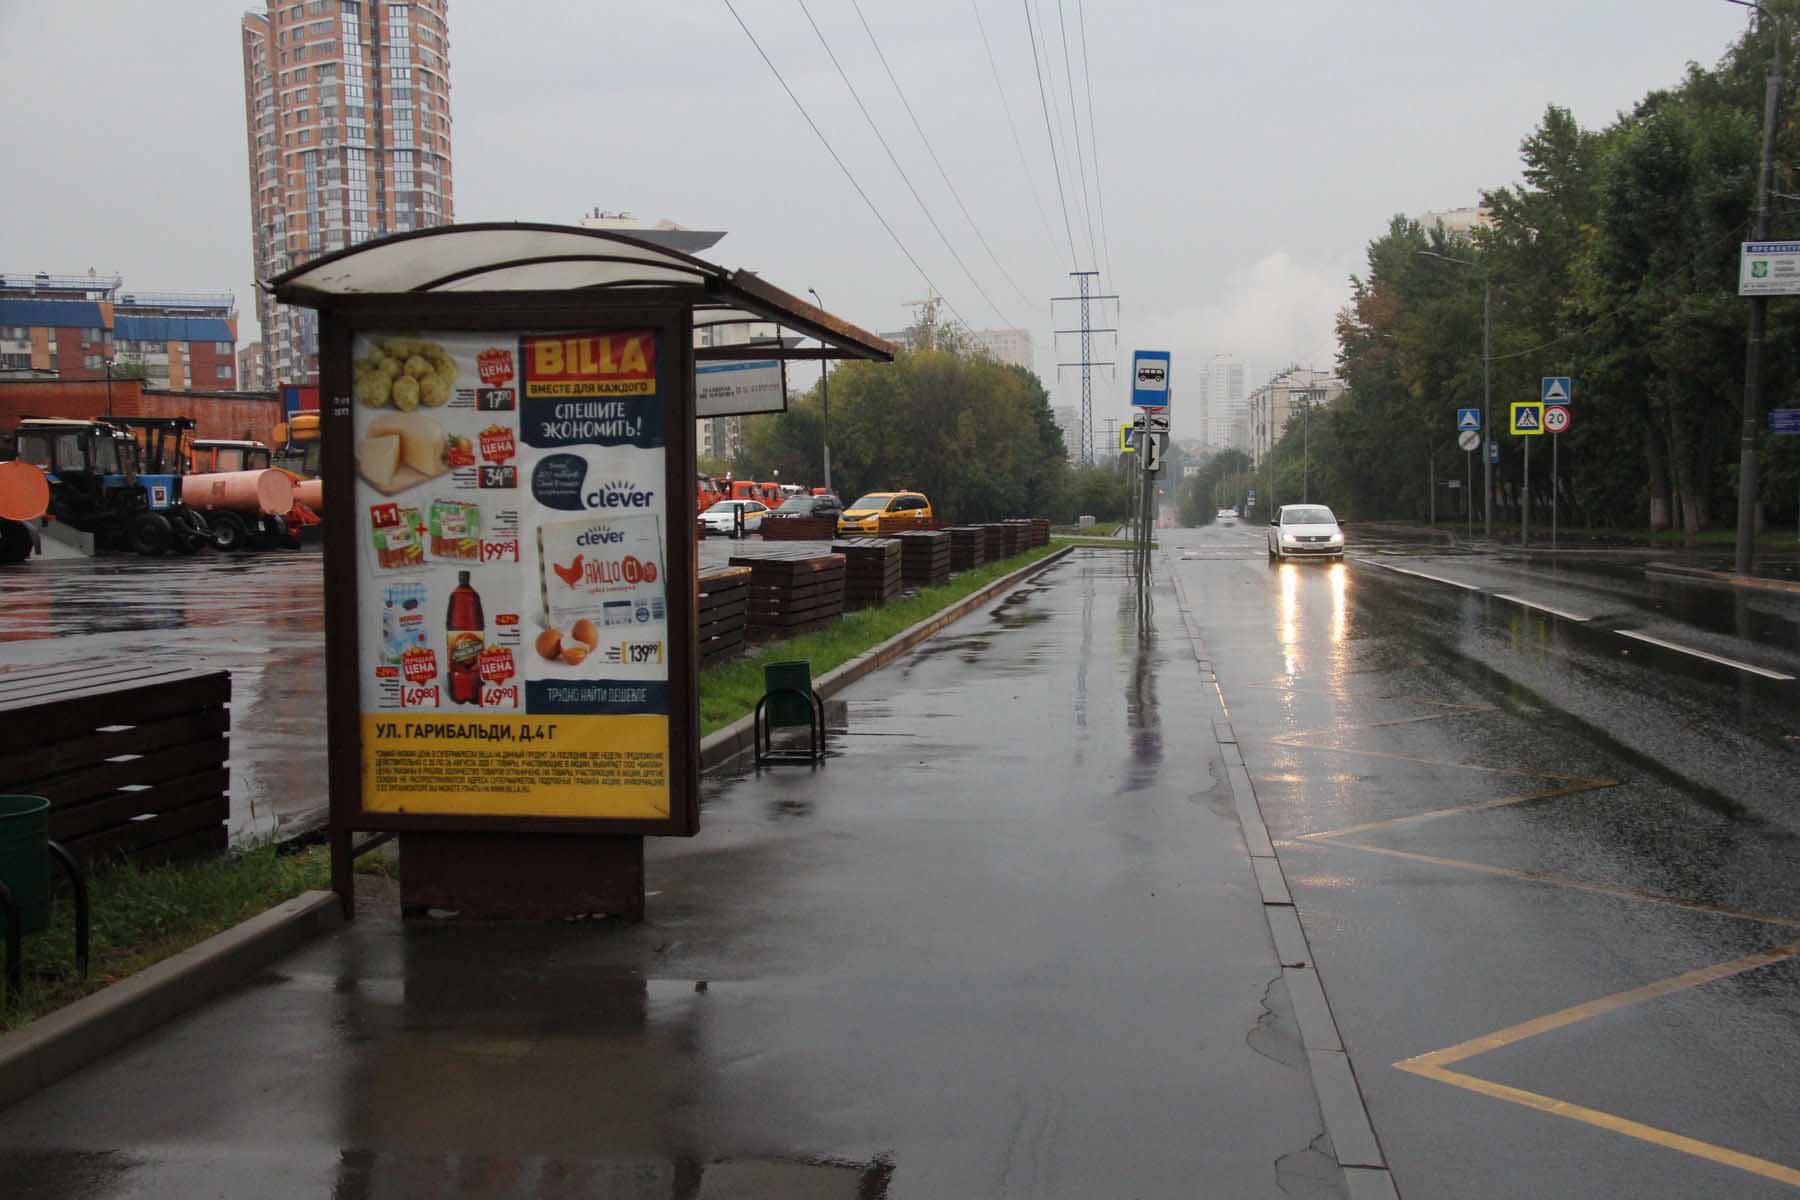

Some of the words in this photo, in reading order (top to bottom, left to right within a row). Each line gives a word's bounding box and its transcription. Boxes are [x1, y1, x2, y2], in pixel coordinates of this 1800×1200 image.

[535, 337, 648, 375] BILLA
[480, 363, 512, 377] ЦЕНА
[530, 384, 571, 394] ВМЕСТЕ
[573, 383, 595, 394] ДЛЯ
[597, 382, 648, 393] КАЖДОГО
[554, 402, 626, 420] СПЕШИТЕ
[1548, 413, 1564, 424] 20
[542, 416, 642, 439] ЭКОНОМИТЬ!
[481, 443, 513, 454] ЦЕНА
[586, 488, 655, 508] clever
[576, 531, 625, 546] clever
[585, 559, 621, 585] ЯЙЦО
[405, 663, 435, 675] ЦЕНА
[481, 662, 513, 674] ЦЕНА
[547, 688, 580, 703] ТРУДНО
[580, 686, 607, 703] НАЙТИ
[607, 687, 648, 703] ДЕШЕВЛЕ
[376, 723, 401, 739] УЛ.
[405, 723, 516, 742] ГАРИБАЛЬДИ,
